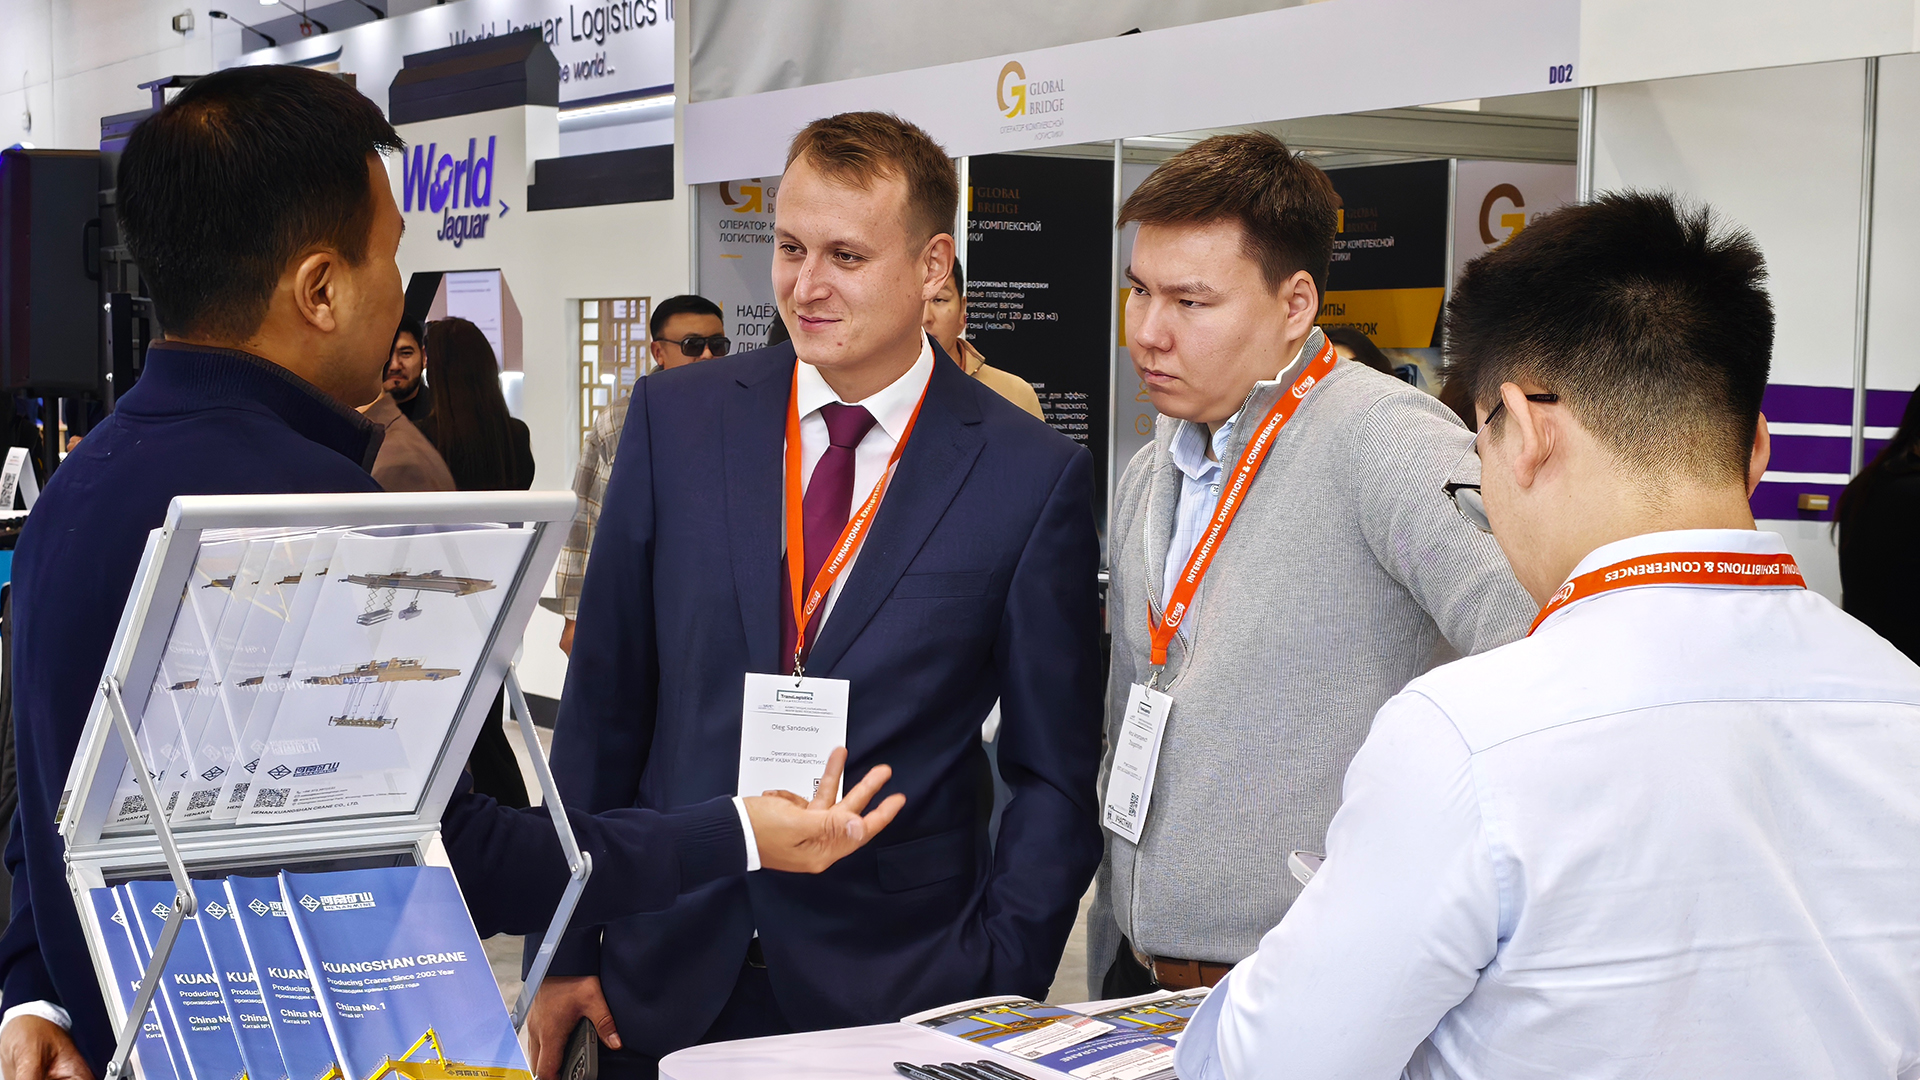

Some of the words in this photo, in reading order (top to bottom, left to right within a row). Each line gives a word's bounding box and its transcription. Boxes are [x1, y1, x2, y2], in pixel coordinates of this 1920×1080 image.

[570, 0, 657, 45] Logistics
[1549, 64, 1573, 84] D02
[1029, 79, 1065, 96] GLOBAL
[1030, 98, 1064, 115] BRIDGE
[403, 135, 497, 214] World
[977, 187, 1020, 199] GLOBAL
[978, 202, 1019, 214] BRIDGE
[437, 207, 490, 248] Jaguar
[719, 219, 767, 231] ОПЕРАТОР
[979, 220, 1042, 232] КОМПЛЕКСНОЙ
[1009, 282, 1049, 290] перевозки
[985, 291, 1025, 300] платформы
[1009, 312, 1022, 320] 120
[1022, 313, 1032, 321] до
[1033, 312, 1046, 320] 158
[1246, 412, 1284, 466] CONFERENCES
[1242, 463, 1251, 474] &
[1217, 472, 1248, 523] EXHIBITIONS
[827, 518, 865, 575] INTERNATIONAL
[1185, 523, 1223, 584] INTERNATIONAL
[1604, 561, 1701, 583] CONFERENCES
[1703, 561, 1715, 573] &
[1717, 562, 1780, 575] EXHIBITIONS
[771, 723, 786, 732] Oleg
[184, 810, 205, 818] HENAN
[274, 806, 313, 815] KUANGSHAN
[322, 956, 416, 974] KUANGSHAN
[416, 951, 468, 966] CRANE
[327, 977, 364, 987] Producing
[363, 976, 392, 986] Cranes
[392, 974, 415, 983] Since
[415, 970, 437, 979] 2002
[437, 969, 455, 977] Year
[272, 983, 310, 994] Producing
[388, 983, 405, 991] 2002
[405, 982, 420, 990] года
[179, 990, 220, 998] Producing
[280, 1008, 308, 1018] China
[335, 1002, 362, 1012] China
[362, 1003, 380, 1012] No.
[379, 1002, 386, 1010] 1
[188, 1015, 218, 1024] China
[240, 1014, 269, 1022] China
[1059, 1047, 1098, 1063] CRANE
